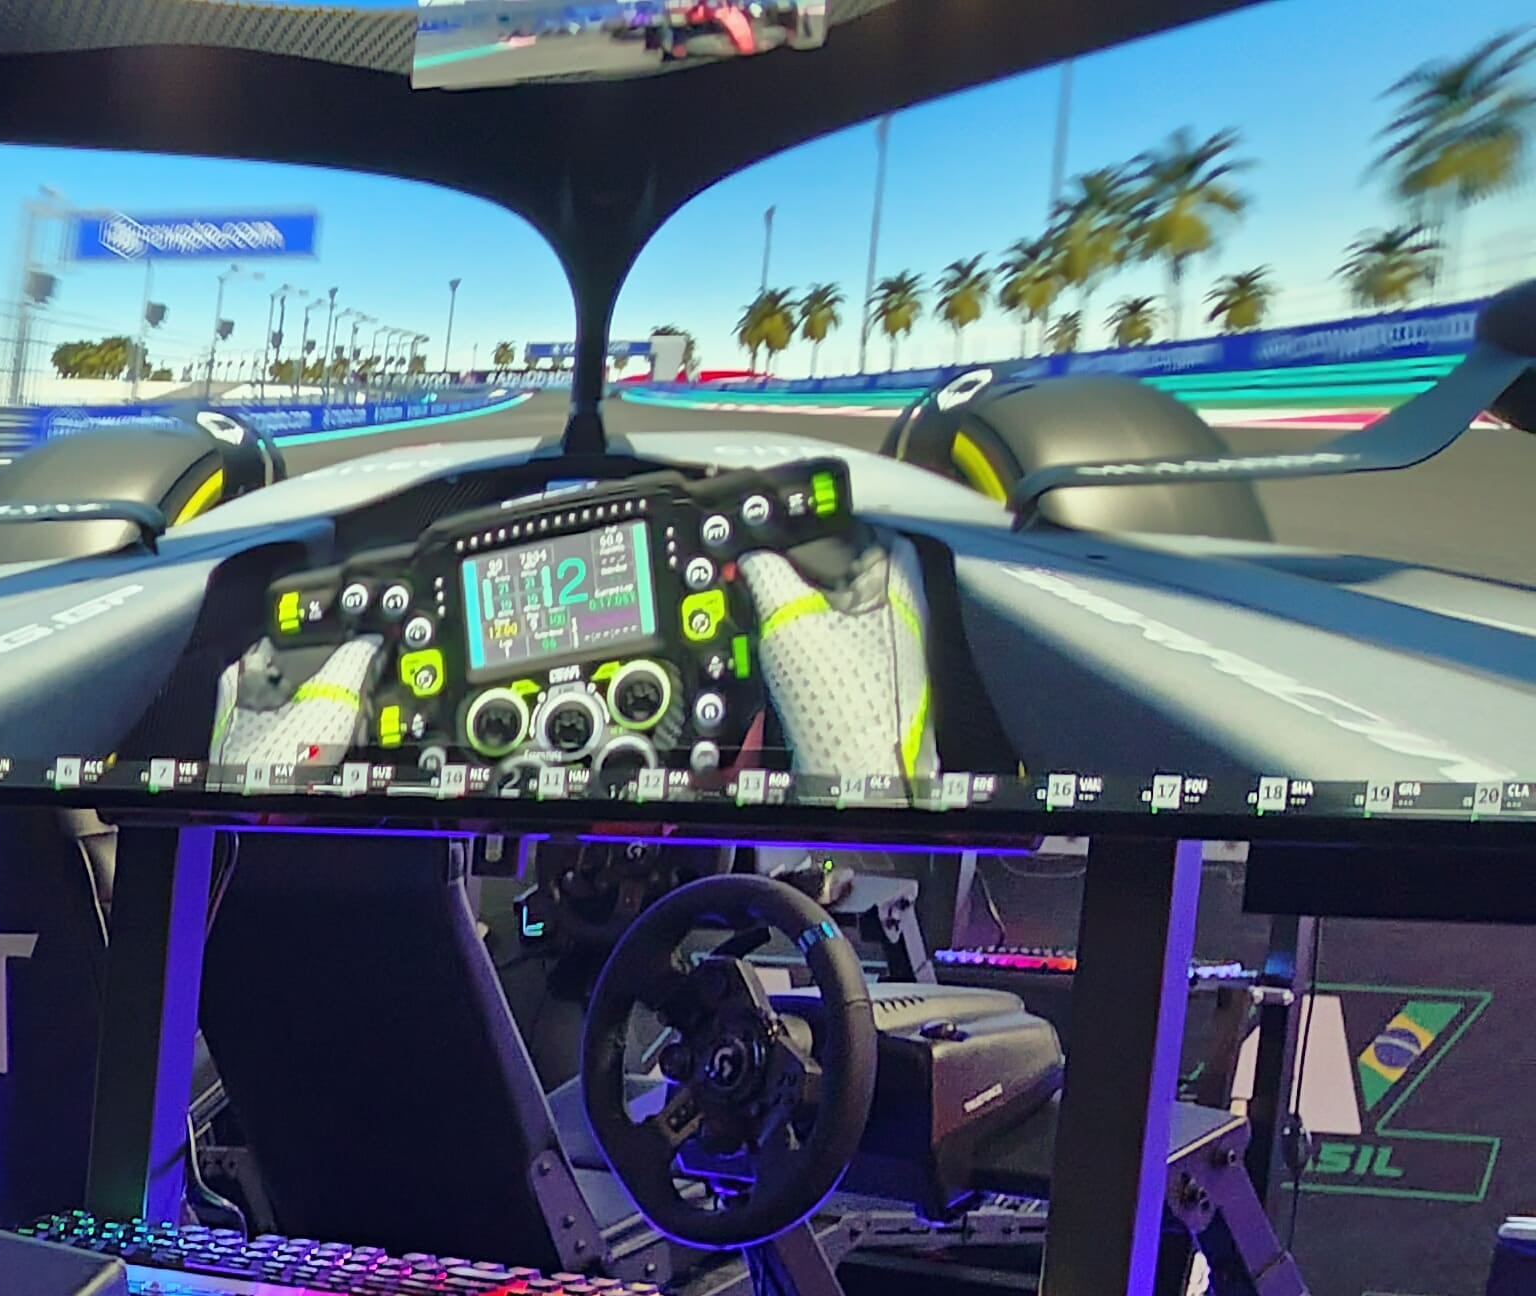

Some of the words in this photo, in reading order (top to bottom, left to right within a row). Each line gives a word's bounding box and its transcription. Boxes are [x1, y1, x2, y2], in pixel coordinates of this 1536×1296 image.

[1052, 781, 1072, 797] 16
[1156, 782, 1177, 798] 17
[1262, 784, 1283, 801] 18
[1369, 785, 1391, 802] 19
[1477, 787, 1500, 804] 20
